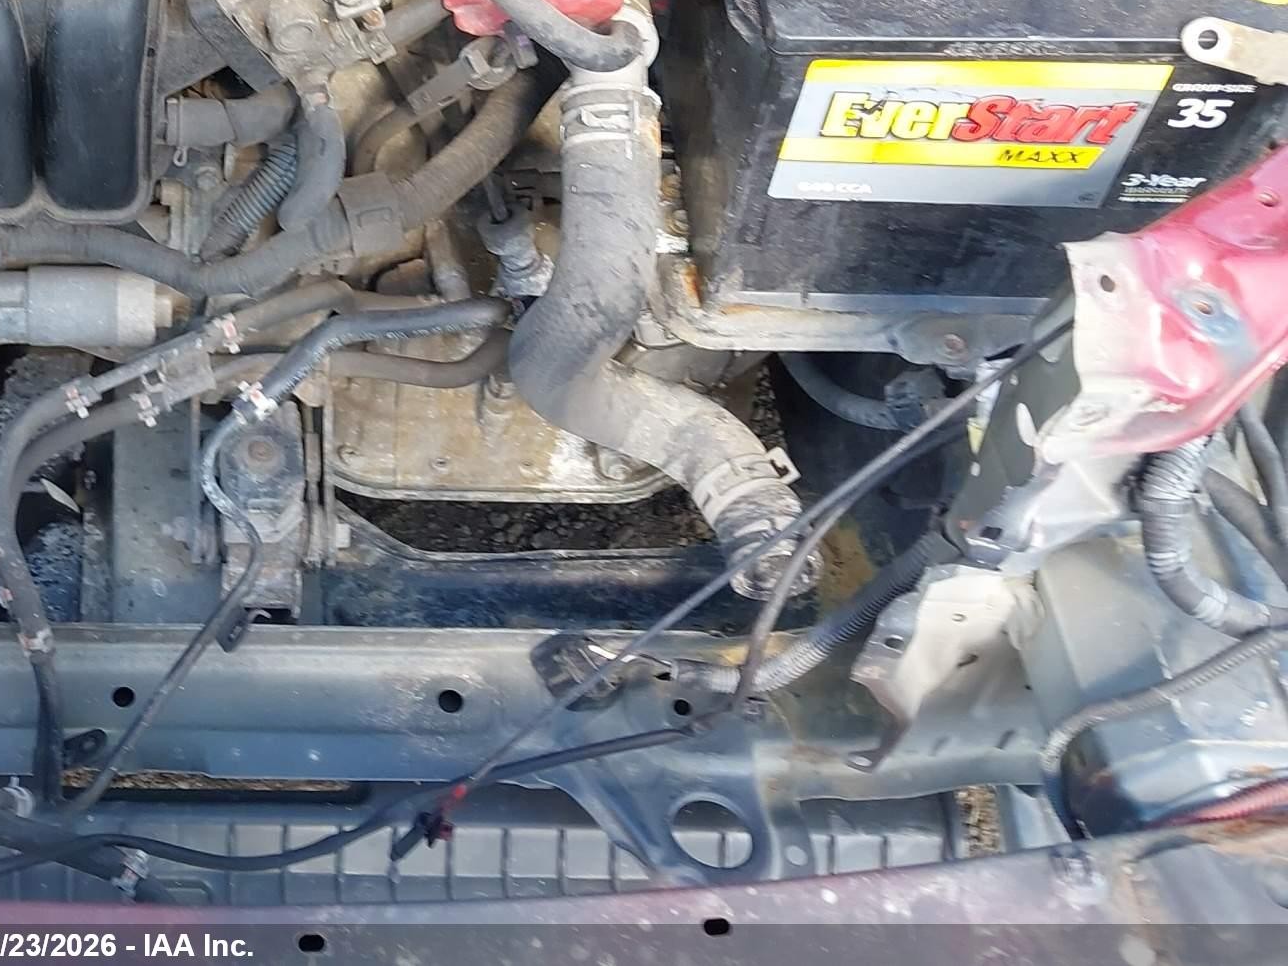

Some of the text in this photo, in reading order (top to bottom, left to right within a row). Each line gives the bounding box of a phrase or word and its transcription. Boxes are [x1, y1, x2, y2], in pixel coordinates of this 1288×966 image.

[819, 90, 1139, 145] EverStart
[1167, 98, 1235, 128] 35
[998, 148, 1088, 164] MAXX
[1121, 173, 1208, 188] 3-Year
